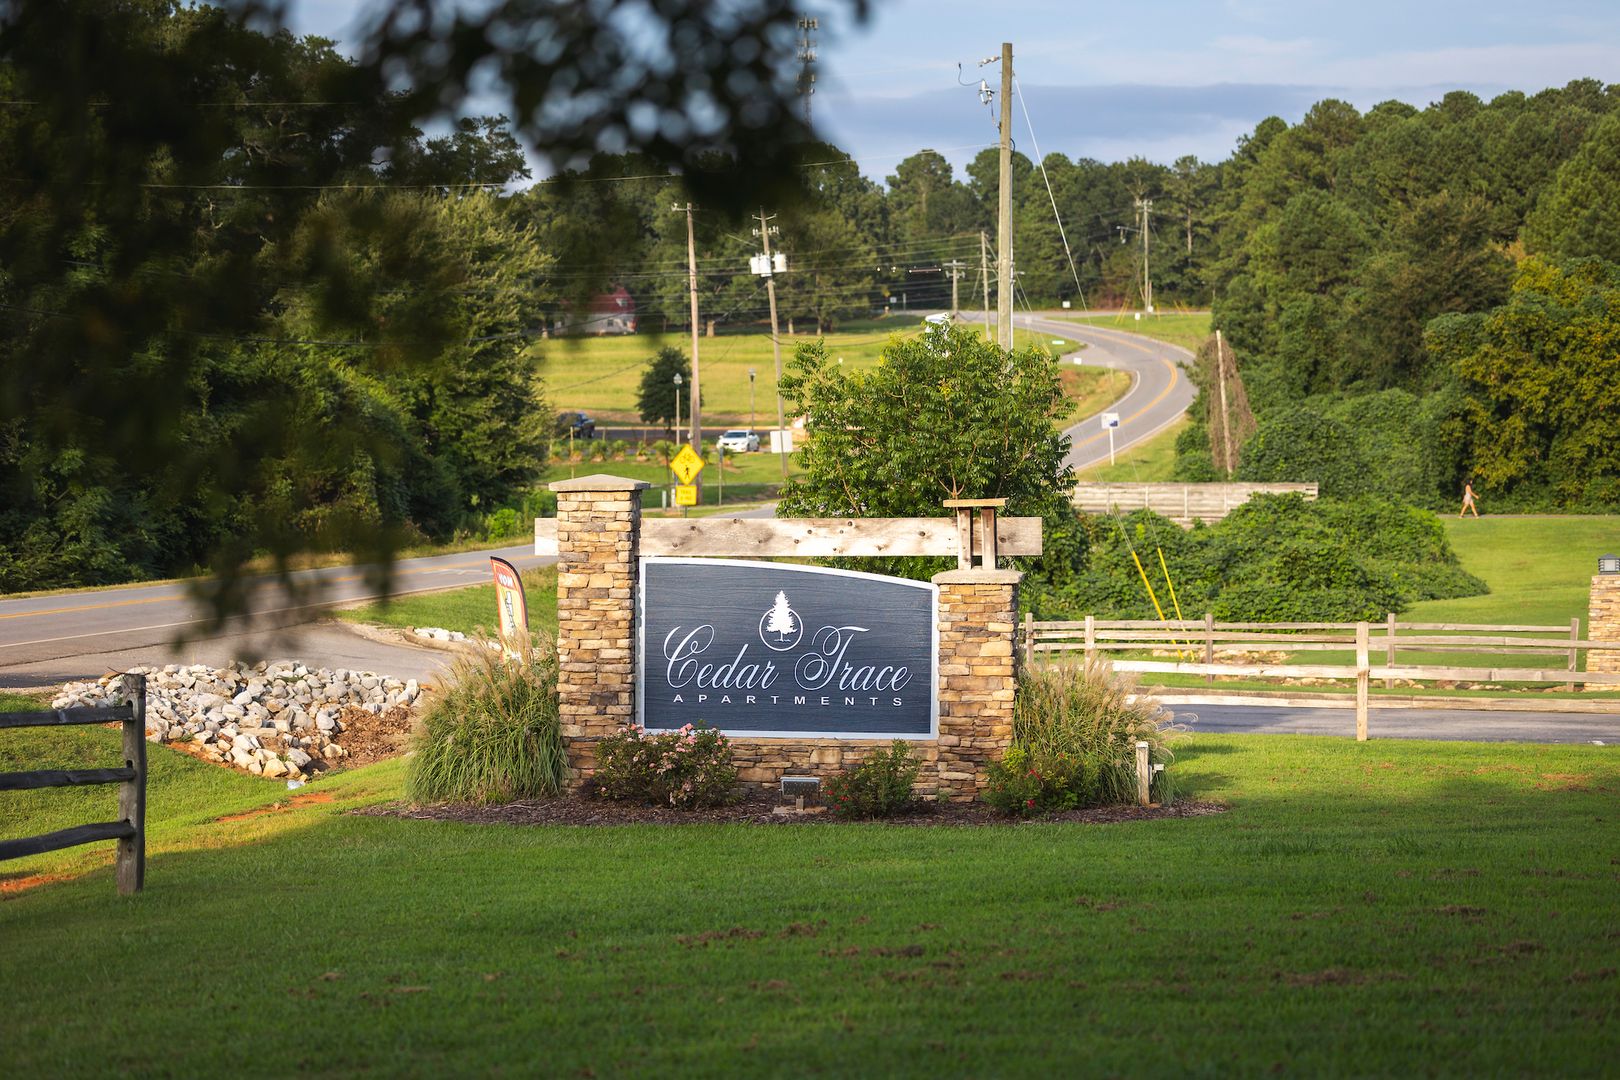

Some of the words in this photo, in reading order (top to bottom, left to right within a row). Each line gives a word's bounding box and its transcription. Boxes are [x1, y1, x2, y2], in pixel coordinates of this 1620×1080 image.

[663, 624, 779, 690] Cedar
[794, 625, 913, 692] Trace
[673, 693, 902, 707] APARTMENTS
